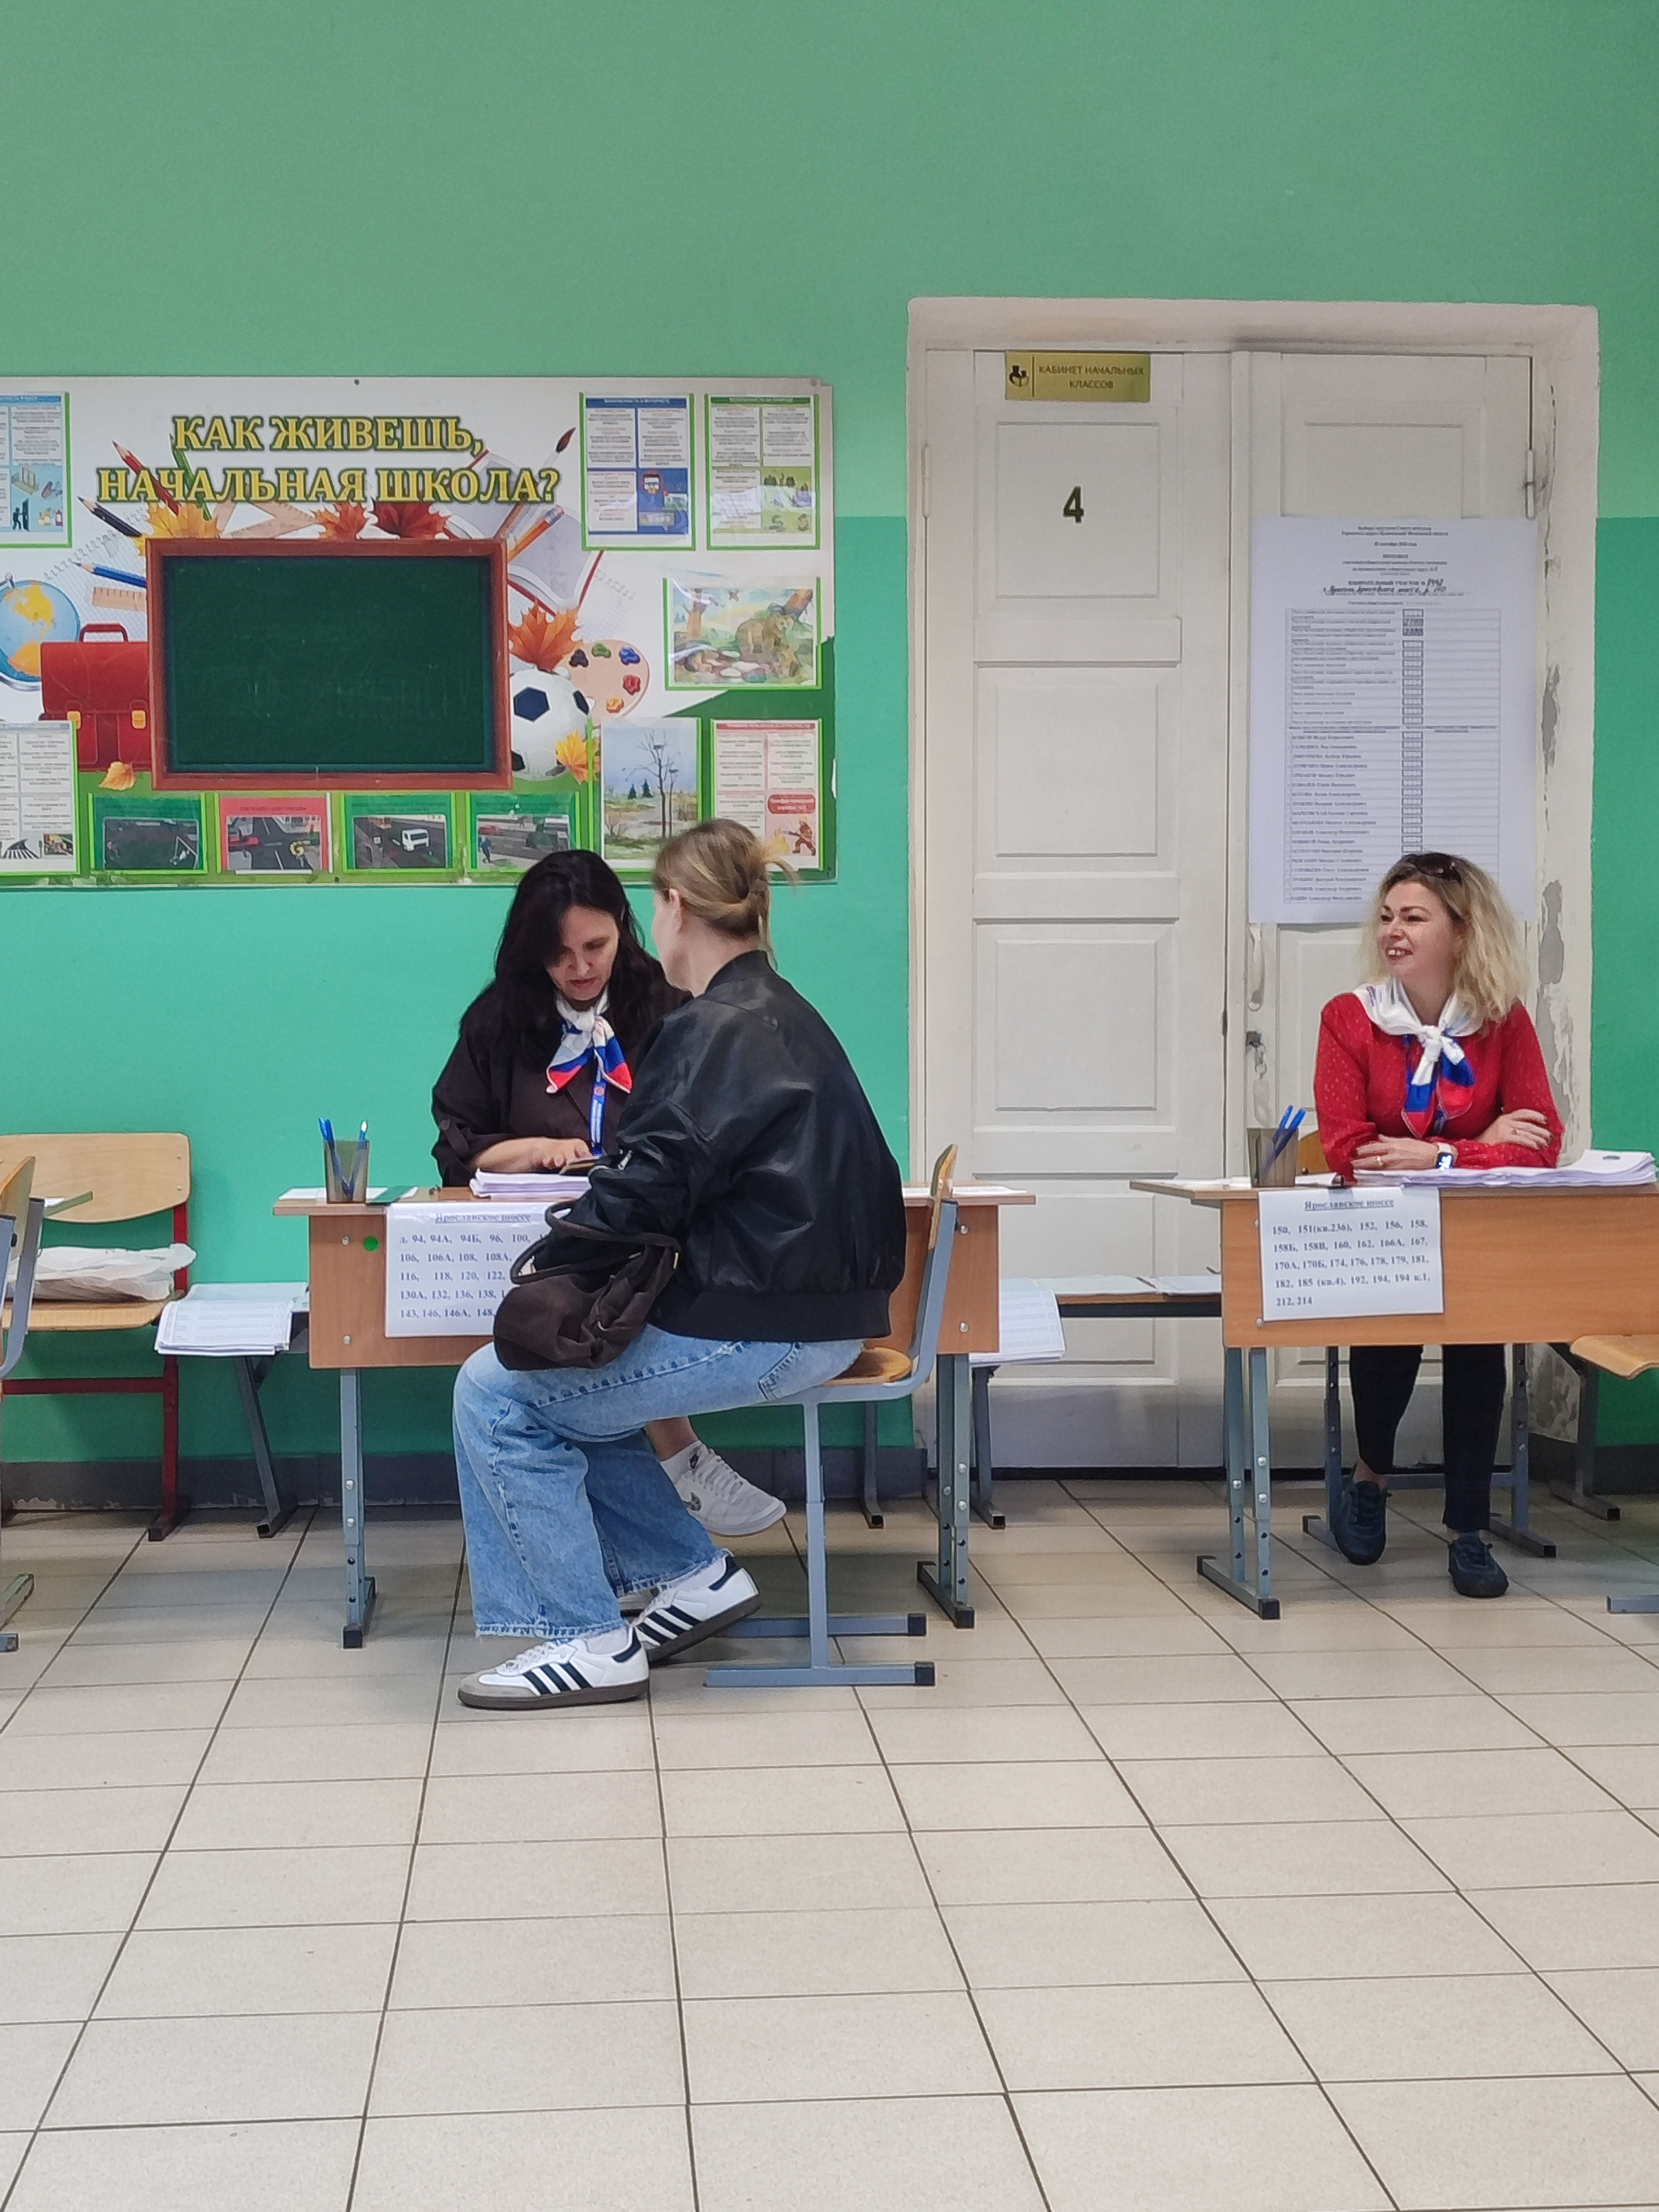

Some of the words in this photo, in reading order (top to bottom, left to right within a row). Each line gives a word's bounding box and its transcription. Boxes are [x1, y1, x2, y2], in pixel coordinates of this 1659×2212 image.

[1039, 365, 1083, 374] КАБИНЕТ
[1085, 366, 1144, 375] НАЧАЛЬНЫХ
[1069, 380, 1114, 389] КЛАССОВ
[172, 416, 264, 451] КАК
[269, 416, 483, 457] ЖИВЕШЬ,
[96, 467, 367, 503] НАЧАЛЬНАЯ
[375, 467, 560, 503] ШКОЛА?
[1063, 486, 1084, 524] 4
[1273, 1226, 1291, 1234] 150,
[1386, 1220, 1403, 1229] 156,
[412, 1235, 426, 1244] 94,
[430, 1234, 452, 1243] 94А,
[489, 1234, 503, 1243] 96,
[512, 1234, 530, 1243] 100,
[1411, 1237, 1428, 1246] 167,
[401, 1254, 419, 1262] 106,
[428, 1253, 454, 1262] 106А,
[459, 1253, 477, 1262] 108,
[486, 1253, 512, 1261] 108А,
[1275, 1261, 1300, 1270] 170А,
[1331, 1259, 1348, 1267] 174,
[1351, 1258, 1368, 1266] 176,
[1371, 1257, 1389, 1265] 178,
[1391, 1256, 1409, 1264] 179,
[400, 1272, 419, 1281] 116,
[435, 1271, 453, 1281] 118,
[461, 1271, 479, 1281] 120,
[487, 1271, 505, 1280] 122,
[1298, 1278, 1313, 1287] 185
[1351, 1275, 1368, 1284] 192,
[1373, 1275, 1391, 1284] 194,
[1395, 1274, 1410, 1282] 194
[400, 1291, 427, 1300] 130А,
[432, 1290, 451, 1300] 132,
[455, 1290, 473, 1299] 136,
[478, 1290, 497, 1299] 138,
[1297, 1296, 1312, 1305] 214
[400, 1309, 419, 1318] 143,
[422, 1309, 441, 1318] 146,
[445, 1308, 471, 1317] 146А,
